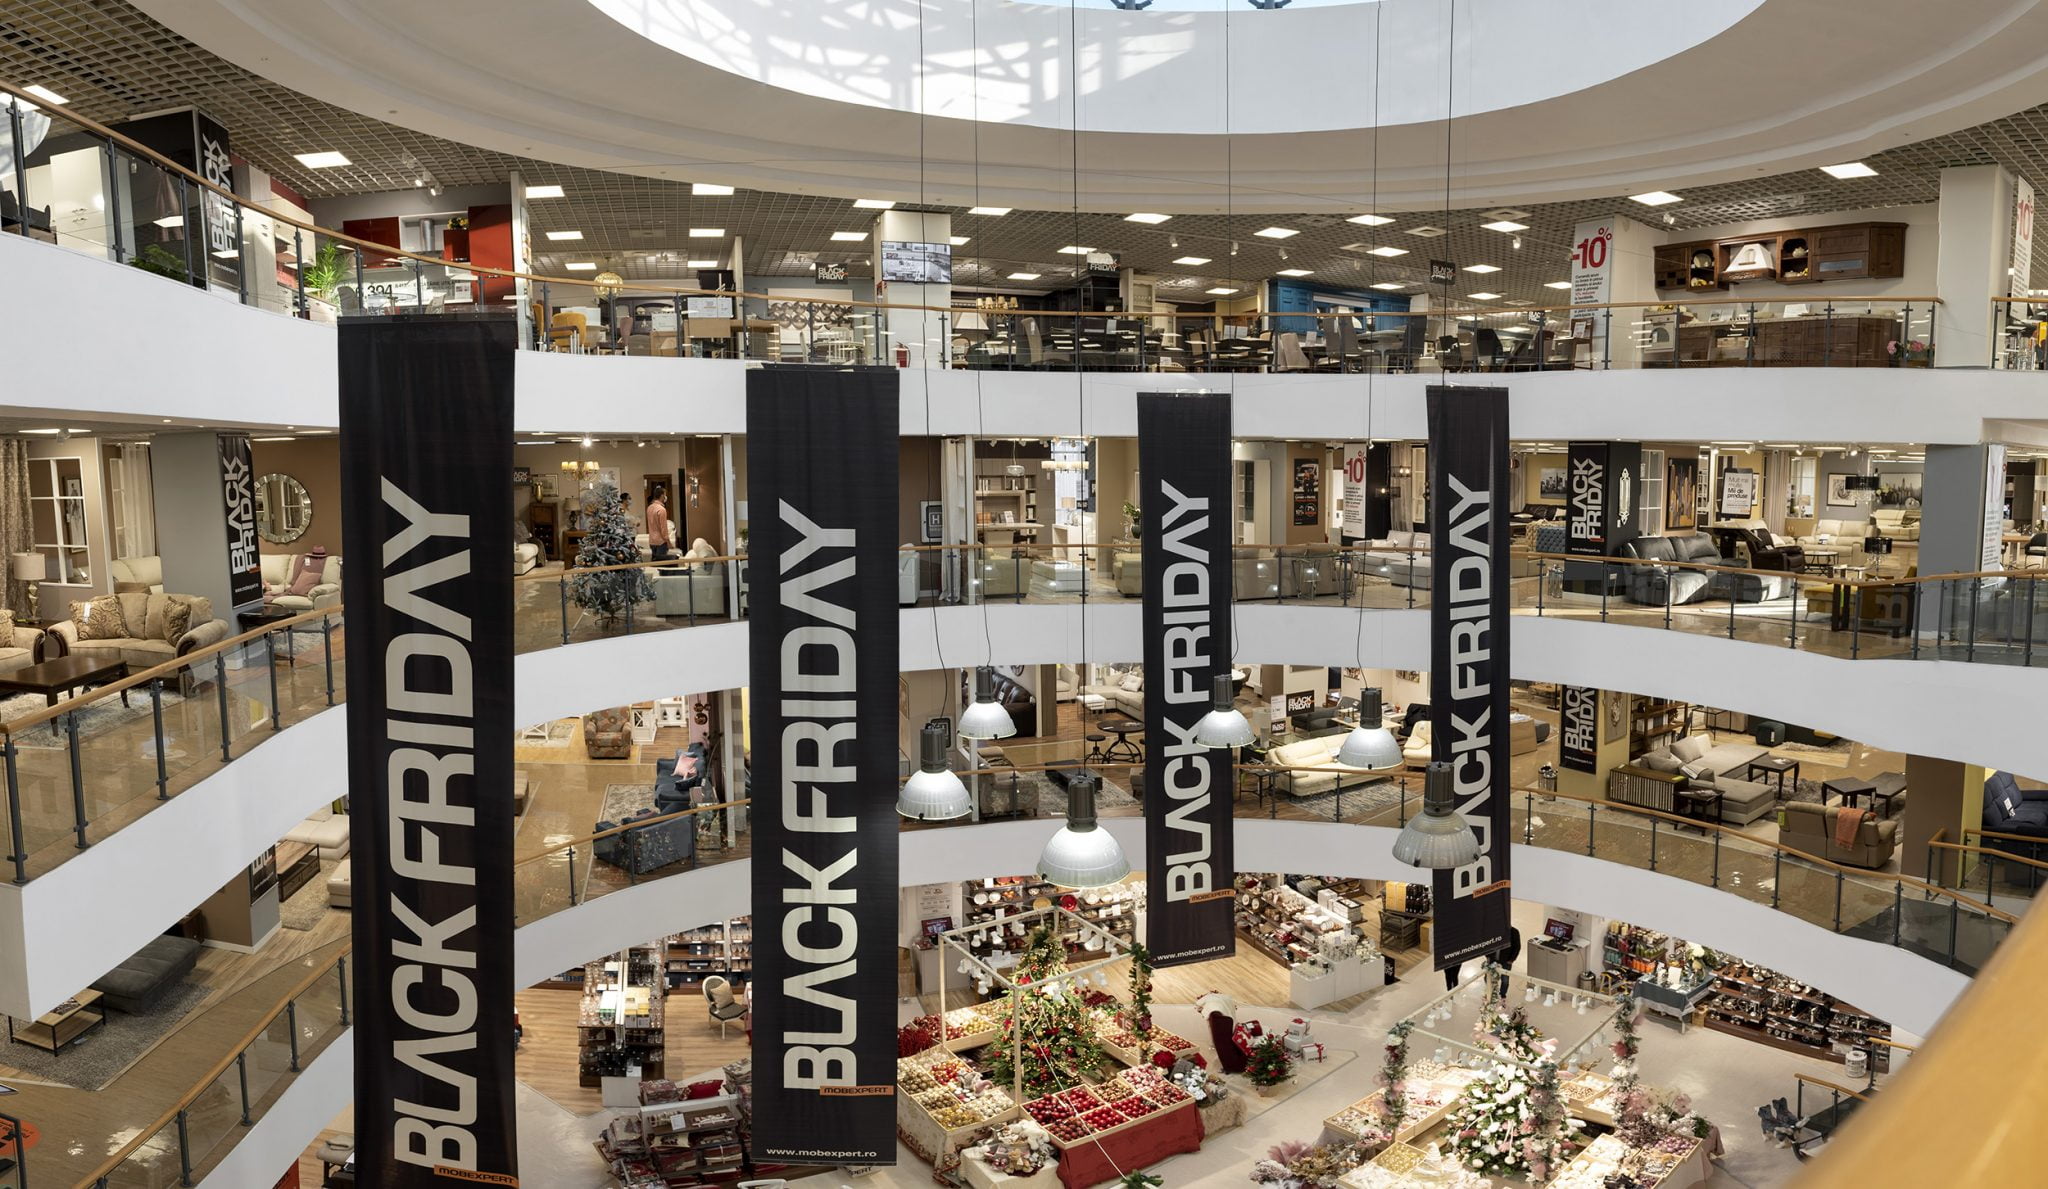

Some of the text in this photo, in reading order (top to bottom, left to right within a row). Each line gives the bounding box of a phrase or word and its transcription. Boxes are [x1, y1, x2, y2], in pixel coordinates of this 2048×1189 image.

[1090, 264, 1117, 272] FRIDAY
[1572, 227, 1612, 269] -10%
[223, 456, 246, 574] BLACK
[237, 457, 257, 572] FRIDAY
[1571, 458, 1590, 539] BLACK
[1586, 459, 1603, 540] FRIDAY
[1448, 473, 1492, 701] FRIDAY
[1161, 479, 1212, 903] BLACK FRIDAY
[1288, 696, 1313, 706] BLACK
[1288, 703, 1312, 712] FRIDAY
[380, 475, 478, 1172] BLACK FRIDAY
[778, 498, 858, 1090] BLACK FRIDAY
[1157, 944, 1226, 961] www.mobexpert.ro
[1444, 935, 1503, 960] www.mobexpert.ro
[766, 1147, 878, 1159] www.mobexpert.ro
